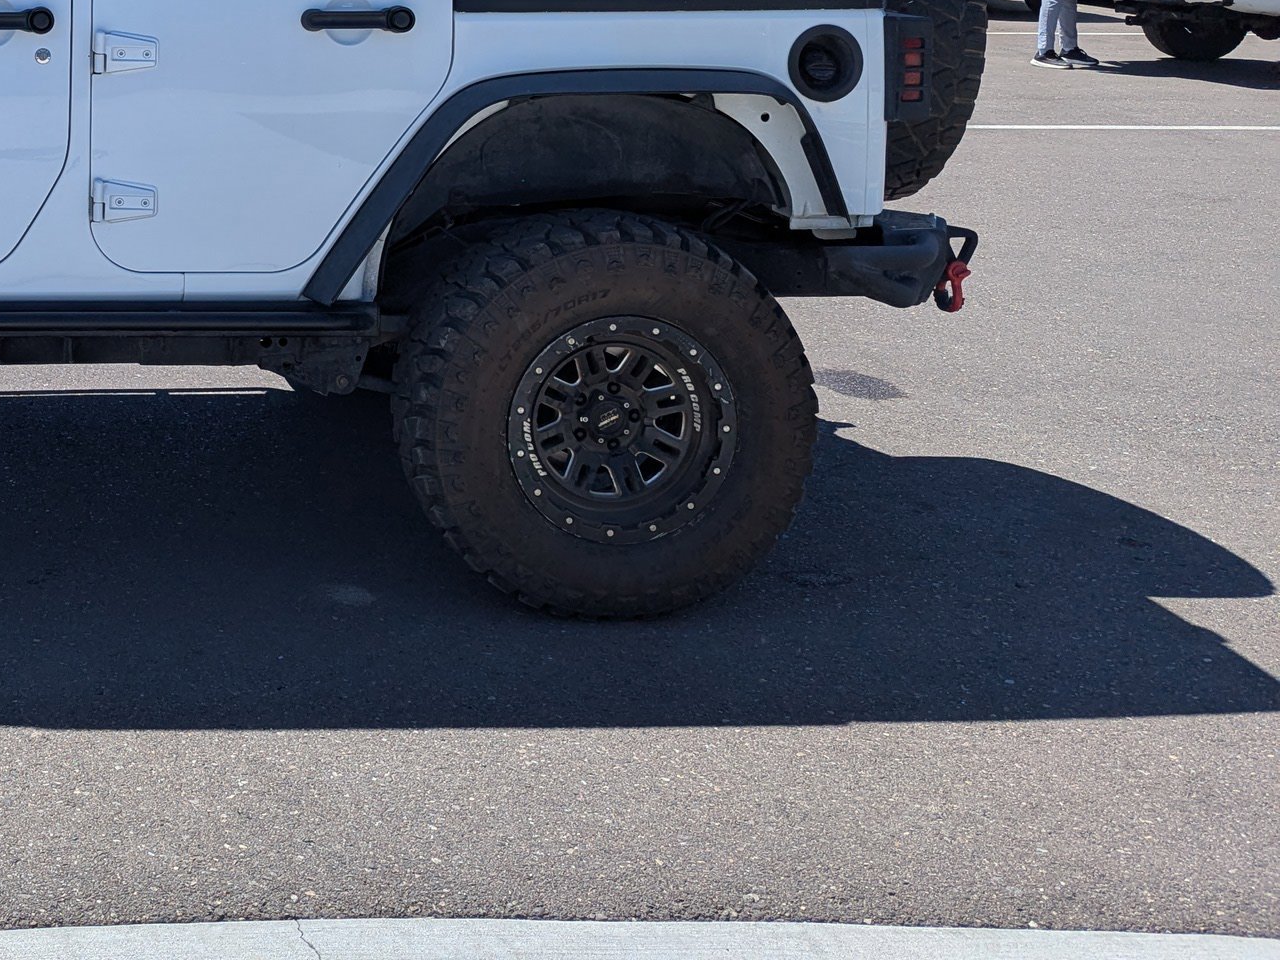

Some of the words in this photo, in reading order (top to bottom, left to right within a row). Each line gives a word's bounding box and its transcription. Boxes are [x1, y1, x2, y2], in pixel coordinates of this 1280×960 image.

[676, 367, 695, 392] PRO
[689, 394, 702, 432] COMP
[529, 453, 548, 477] PRO
